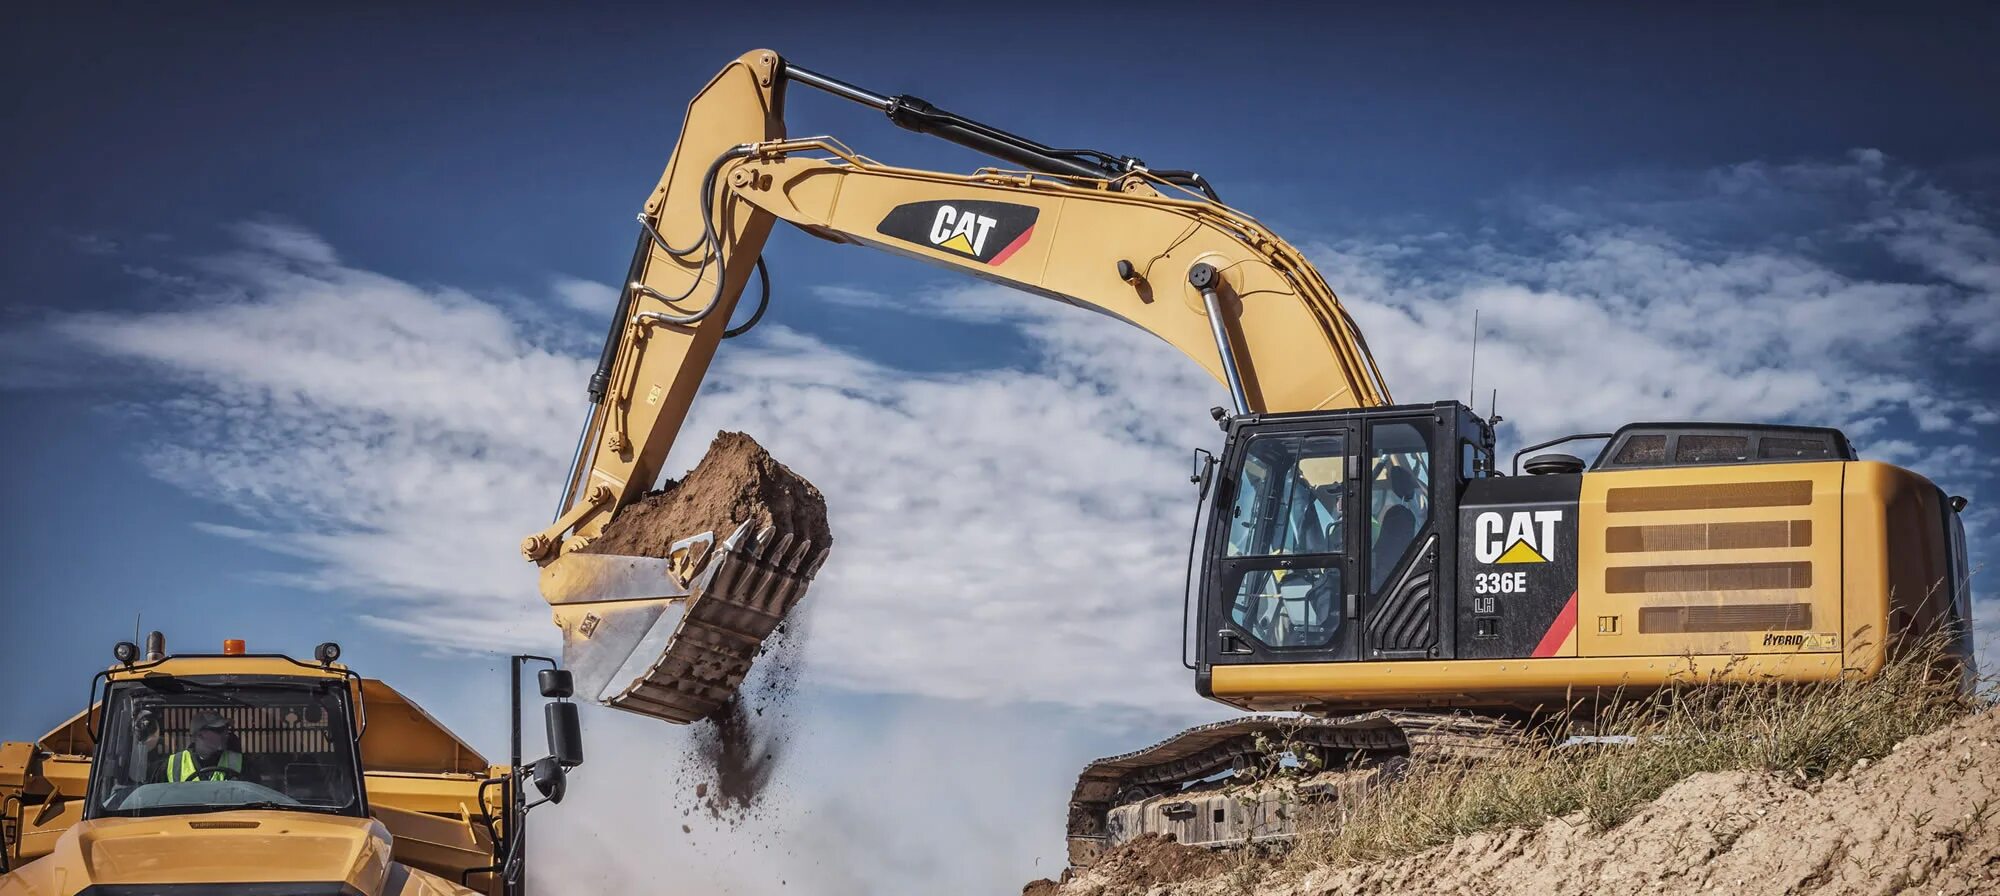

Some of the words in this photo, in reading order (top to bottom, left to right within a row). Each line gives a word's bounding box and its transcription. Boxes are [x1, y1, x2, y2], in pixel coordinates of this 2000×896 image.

[930, 205, 997, 256] CAT
[1475, 510, 1562, 563] CAT
[1475, 572, 1526, 594] 336E
[1475, 597, 1494, 613] LH
